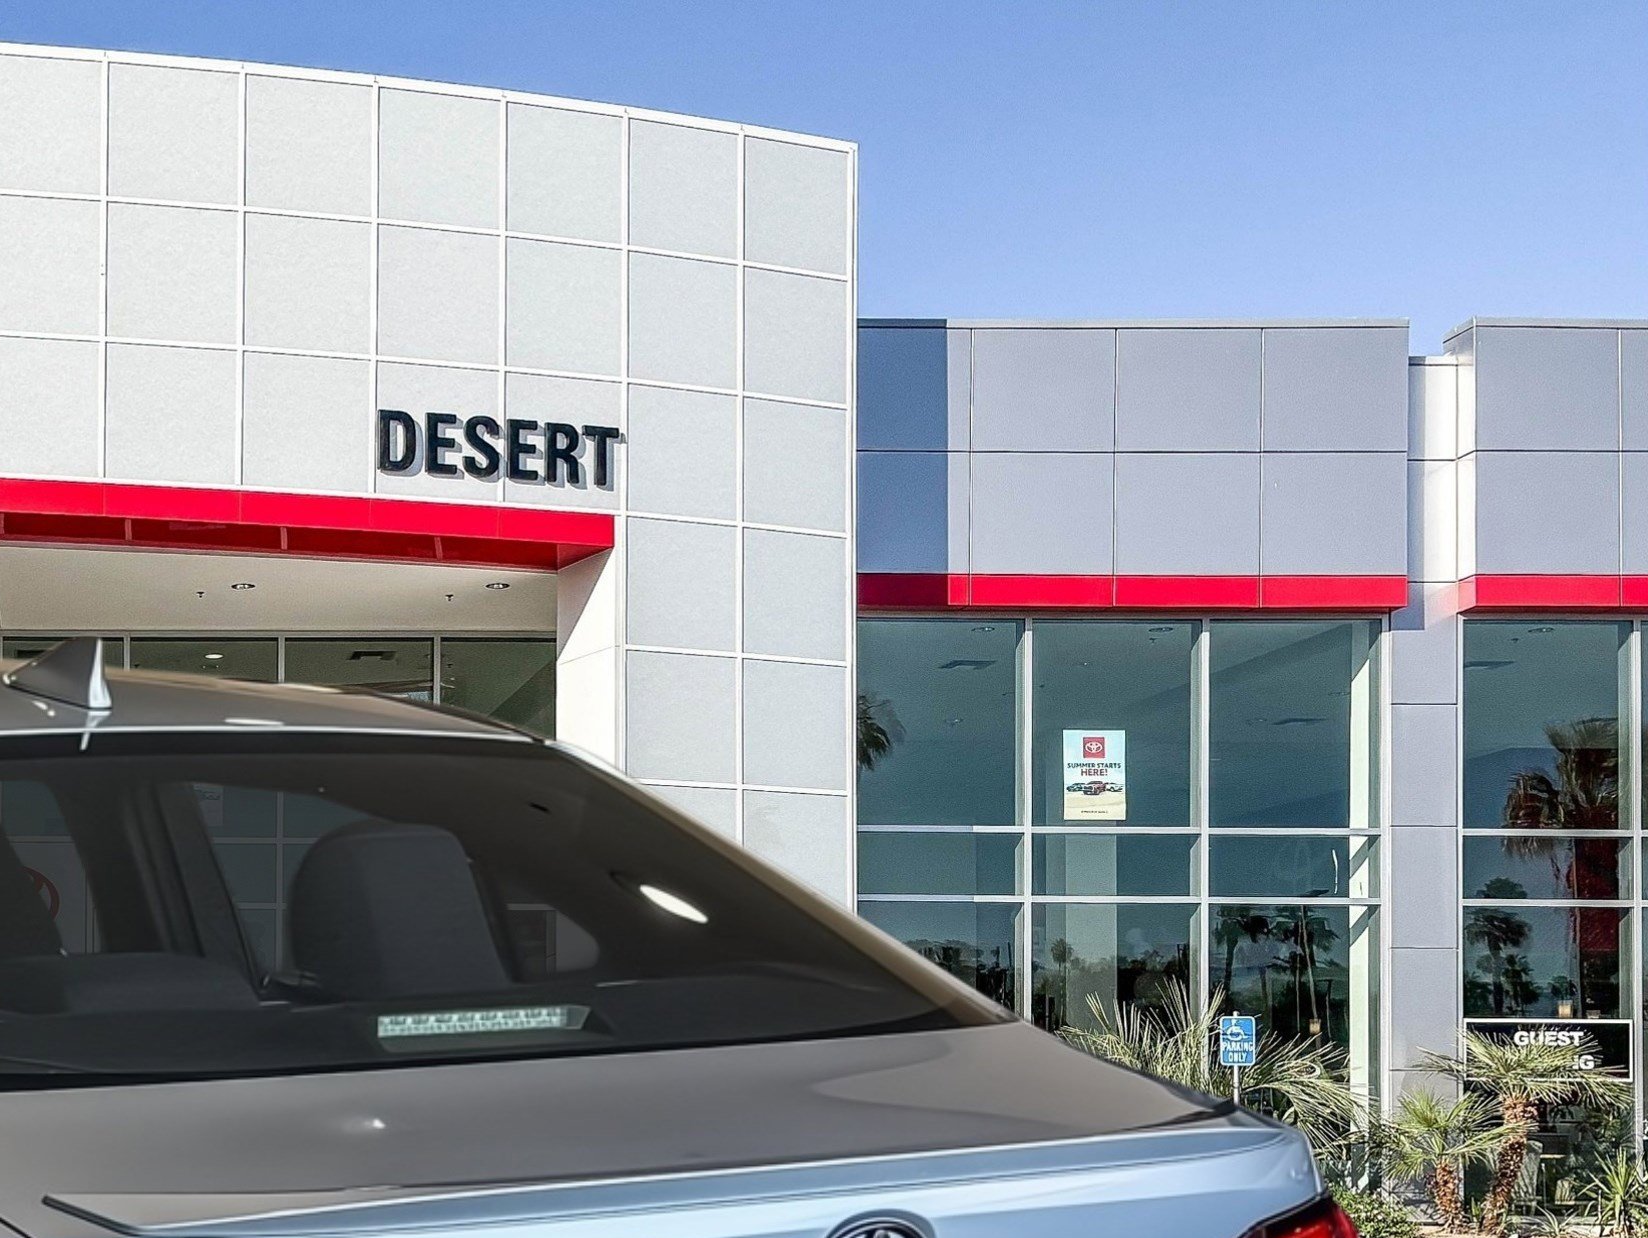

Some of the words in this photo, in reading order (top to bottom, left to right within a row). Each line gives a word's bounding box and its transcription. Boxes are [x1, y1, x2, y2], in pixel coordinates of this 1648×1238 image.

[377, 409, 620, 486] DESERT
[1513, 1031, 1584, 1046] GUEST
[1222, 1041, 1254, 1052] PARKING
[1228, 1052, 1247, 1062] ONLY
